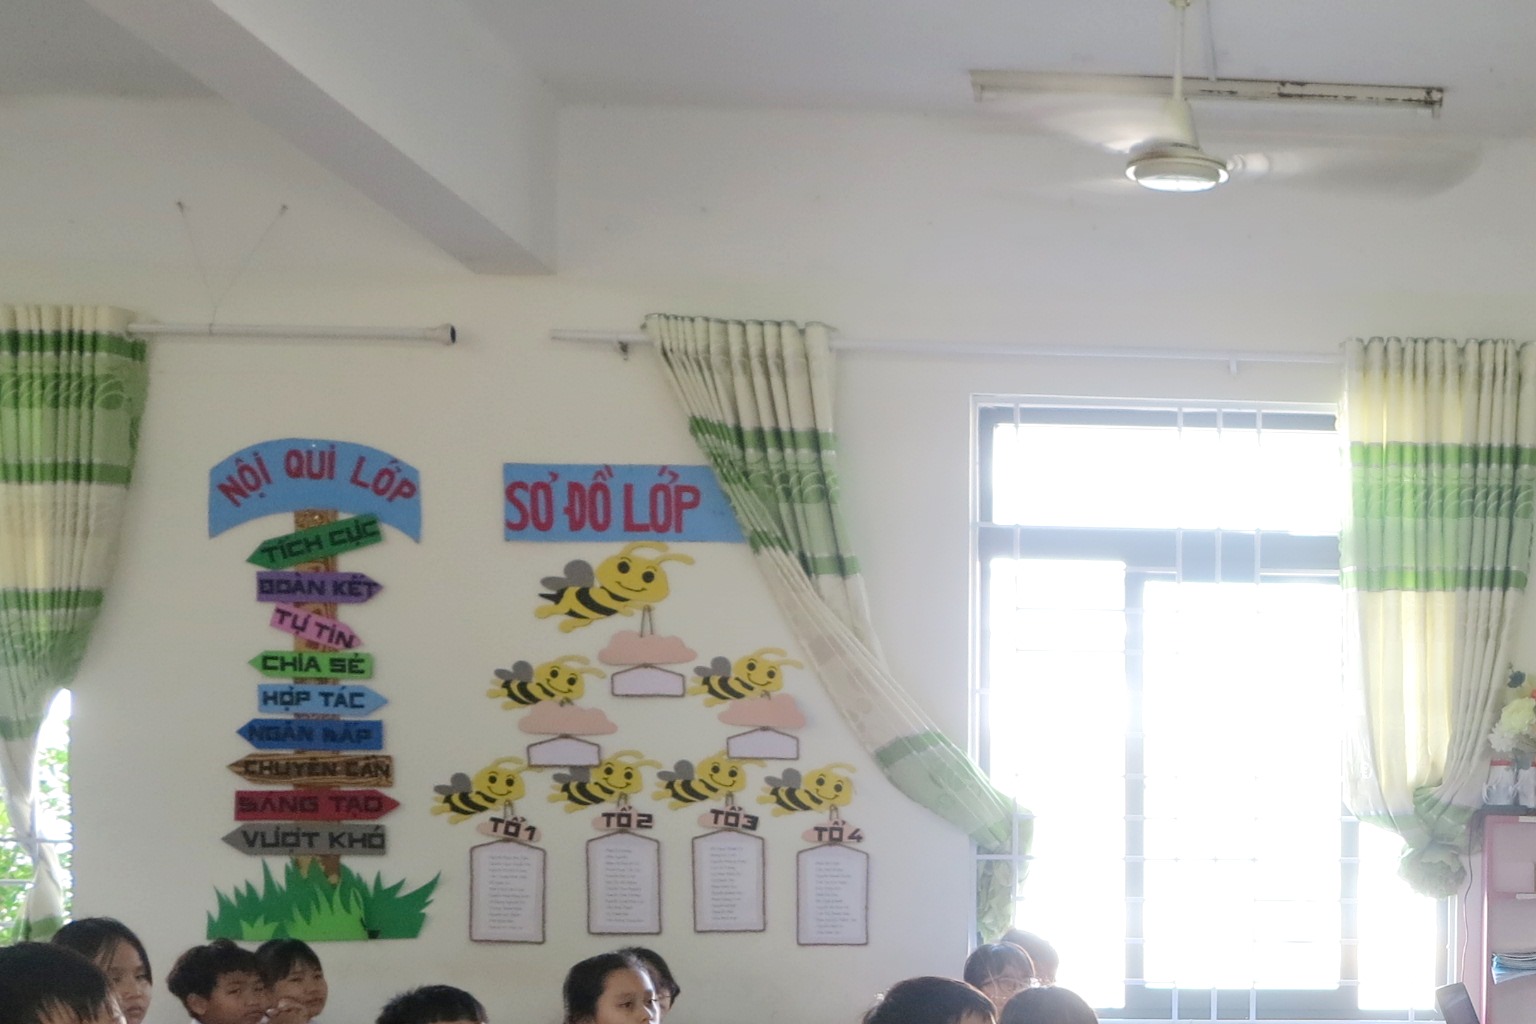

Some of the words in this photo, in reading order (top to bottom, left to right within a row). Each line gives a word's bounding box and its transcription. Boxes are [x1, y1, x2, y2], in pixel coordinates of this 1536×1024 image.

[563, 463, 614, 533] ĐỒ
[623, 464, 702, 534] LỚP
[318, 686, 365, 709] TÁC
[601, 806, 633, 828] TỔ
[636, 813, 653, 829] 2
[710, 805, 743, 828] TỔ
[742, 814, 760, 831] 3
[327, 824, 386, 850] KHÓ
[813, 820, 847, 842] TỔ
[848, 828, 864, 843] 4
